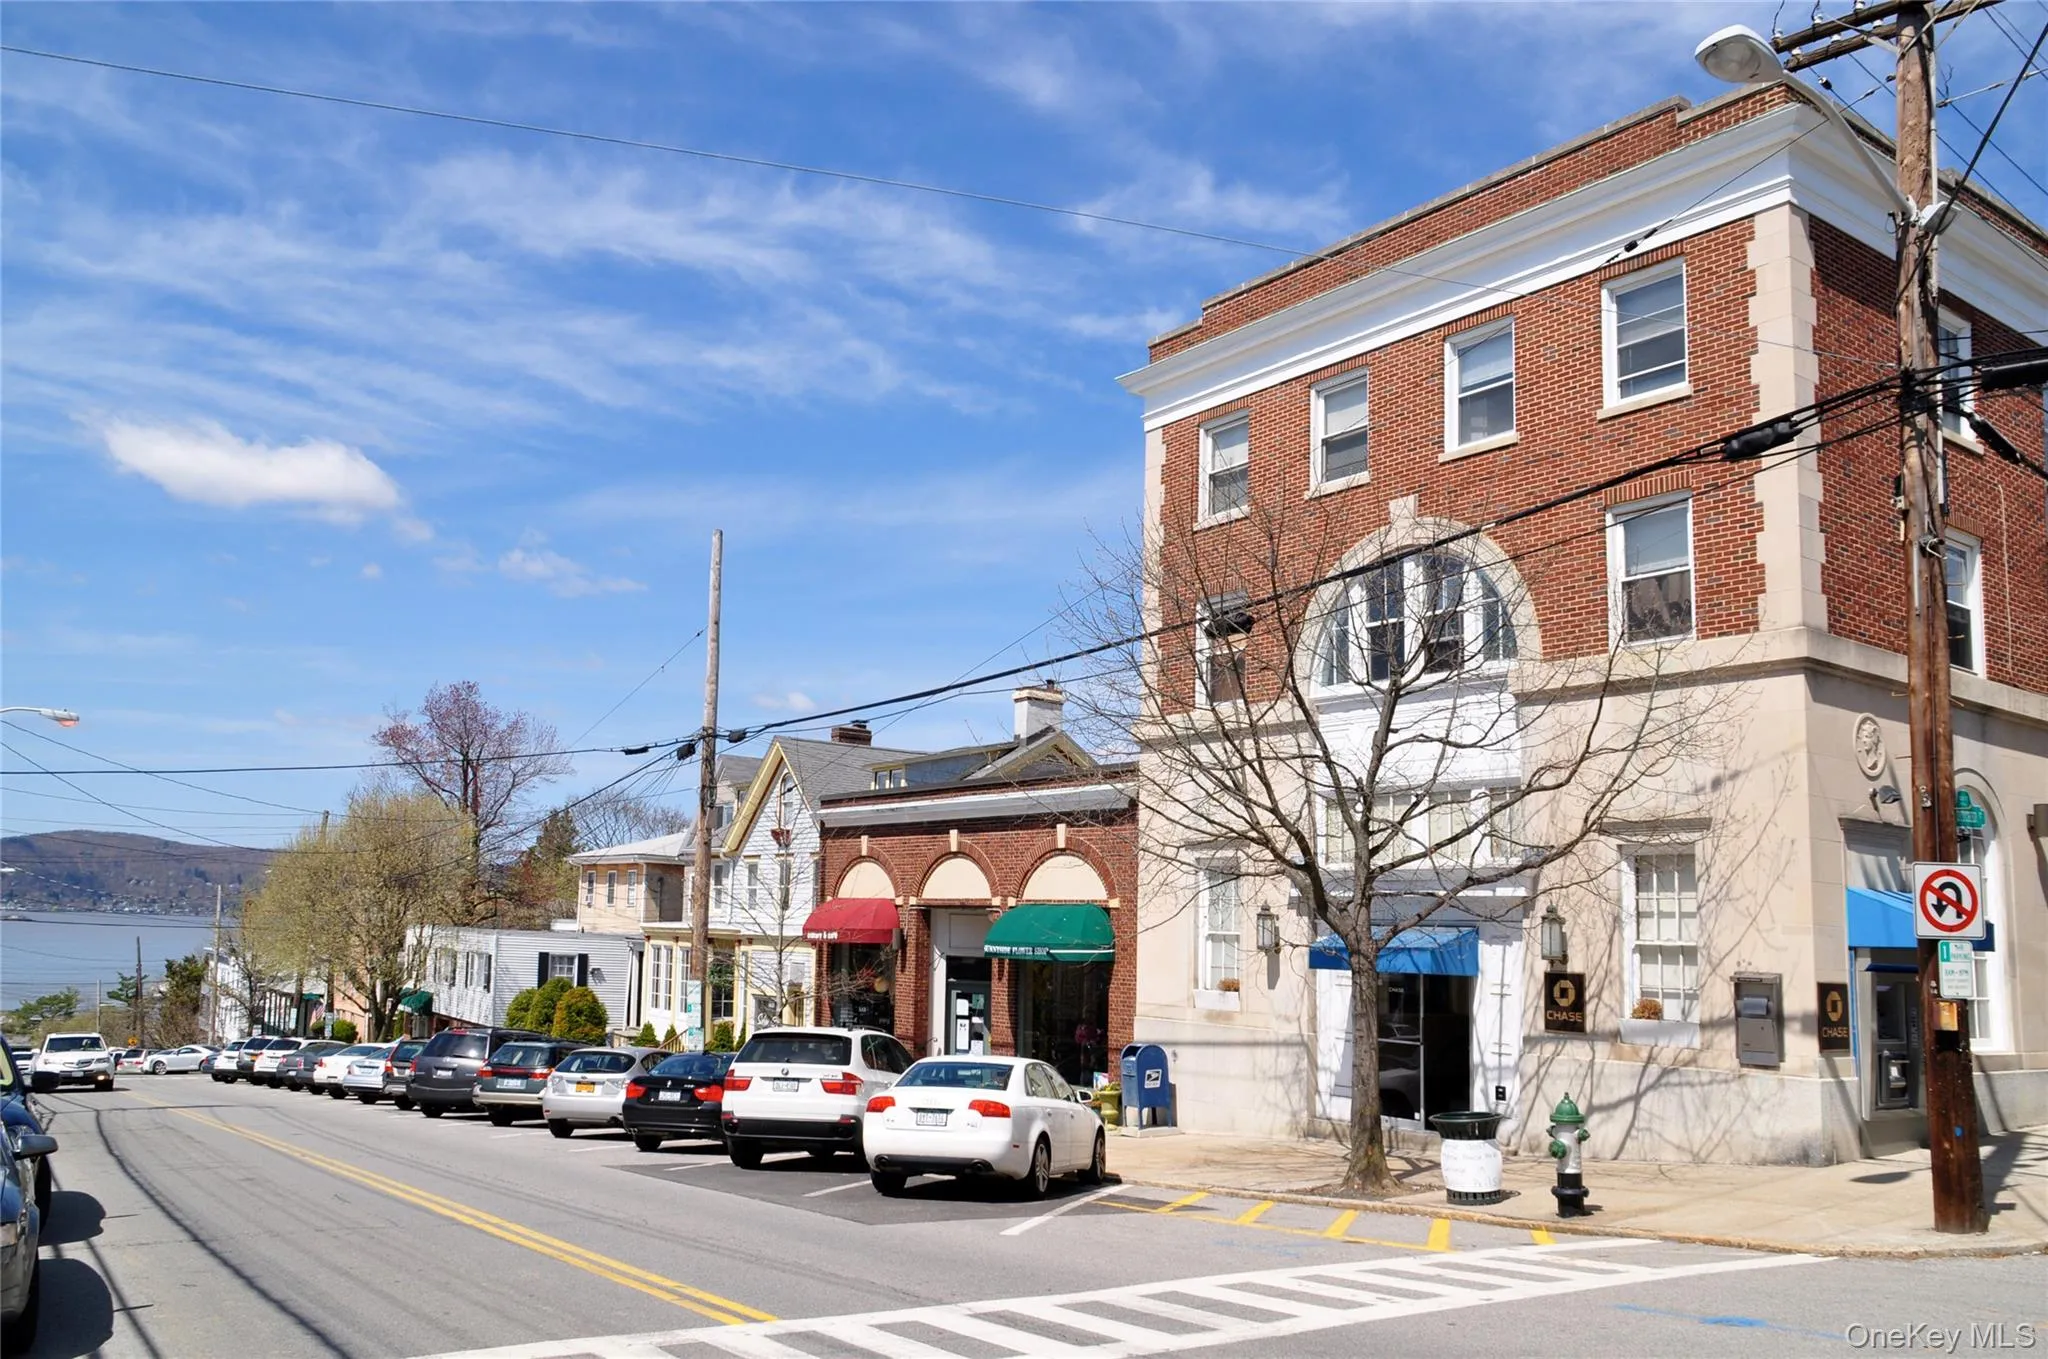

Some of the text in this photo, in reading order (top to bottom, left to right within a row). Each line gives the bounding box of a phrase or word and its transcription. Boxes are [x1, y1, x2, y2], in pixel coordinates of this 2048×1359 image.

[1012, 946, 1033, 955] FLOWER
[1034, 946, 1049, 955] SHOP
[1546, 1010, 1583, 1022] CHASE
[1823, 1027, 1848, 1038] CHASE
